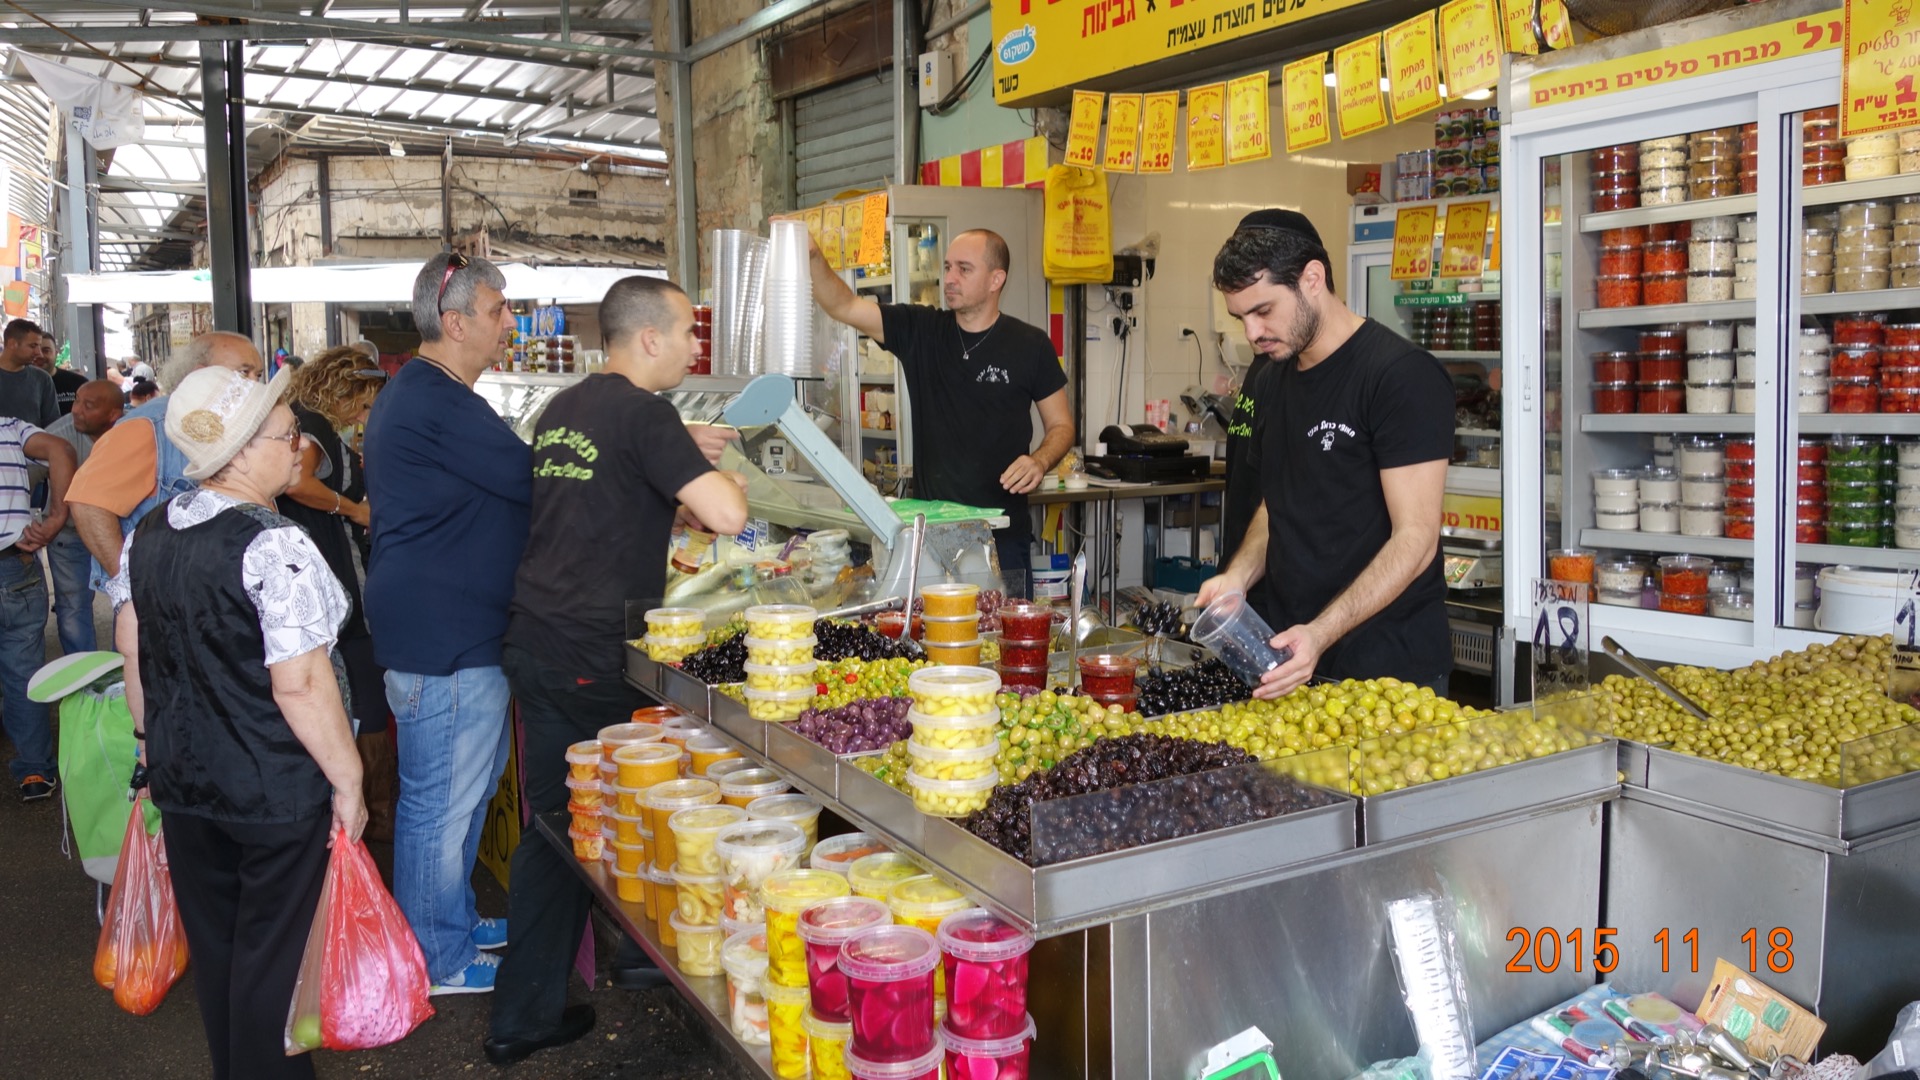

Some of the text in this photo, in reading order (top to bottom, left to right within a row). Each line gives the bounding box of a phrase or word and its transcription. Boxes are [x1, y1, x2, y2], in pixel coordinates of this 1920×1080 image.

[1082, 0, 1136, 38] גבינות
[1212, 3, 1255, 34] תוצרת
[1167, 19, 1206, 48] עצמית
[1857, 29, 1900, 56] סלטים
[1476, 50, 1496, 68] 15
[1707, 40, 1781, 68] מבחר
[1399, 58, 1425, 81] צפתית
[1617, 58, 1699, 89] סלטים
[998, 73, 1019, 94] כשר
[1415, 75, 1432, 94] 10
[1534, 78, 1609, 104] ביתיים
[1854, 94, 1888, 112] ש"ח
[1309, 112, 1322, 128] 20
[1878, 107, 1918, 123] בלבד
[1249, 132, 1262, 147] 10
[1080, 146, 1093, 161] 10
[1119, 150, 1133, 165] 10
[1155, 152, 1170, 167] 10
[1409, 258, 1427, 273] 10
[1460, 255, 1479, 271] 20
[1446, 293, 1463, 304] צבר
[1466, 514, 1500, 532] בחר
[1533, 605, 1580, 672] 18
